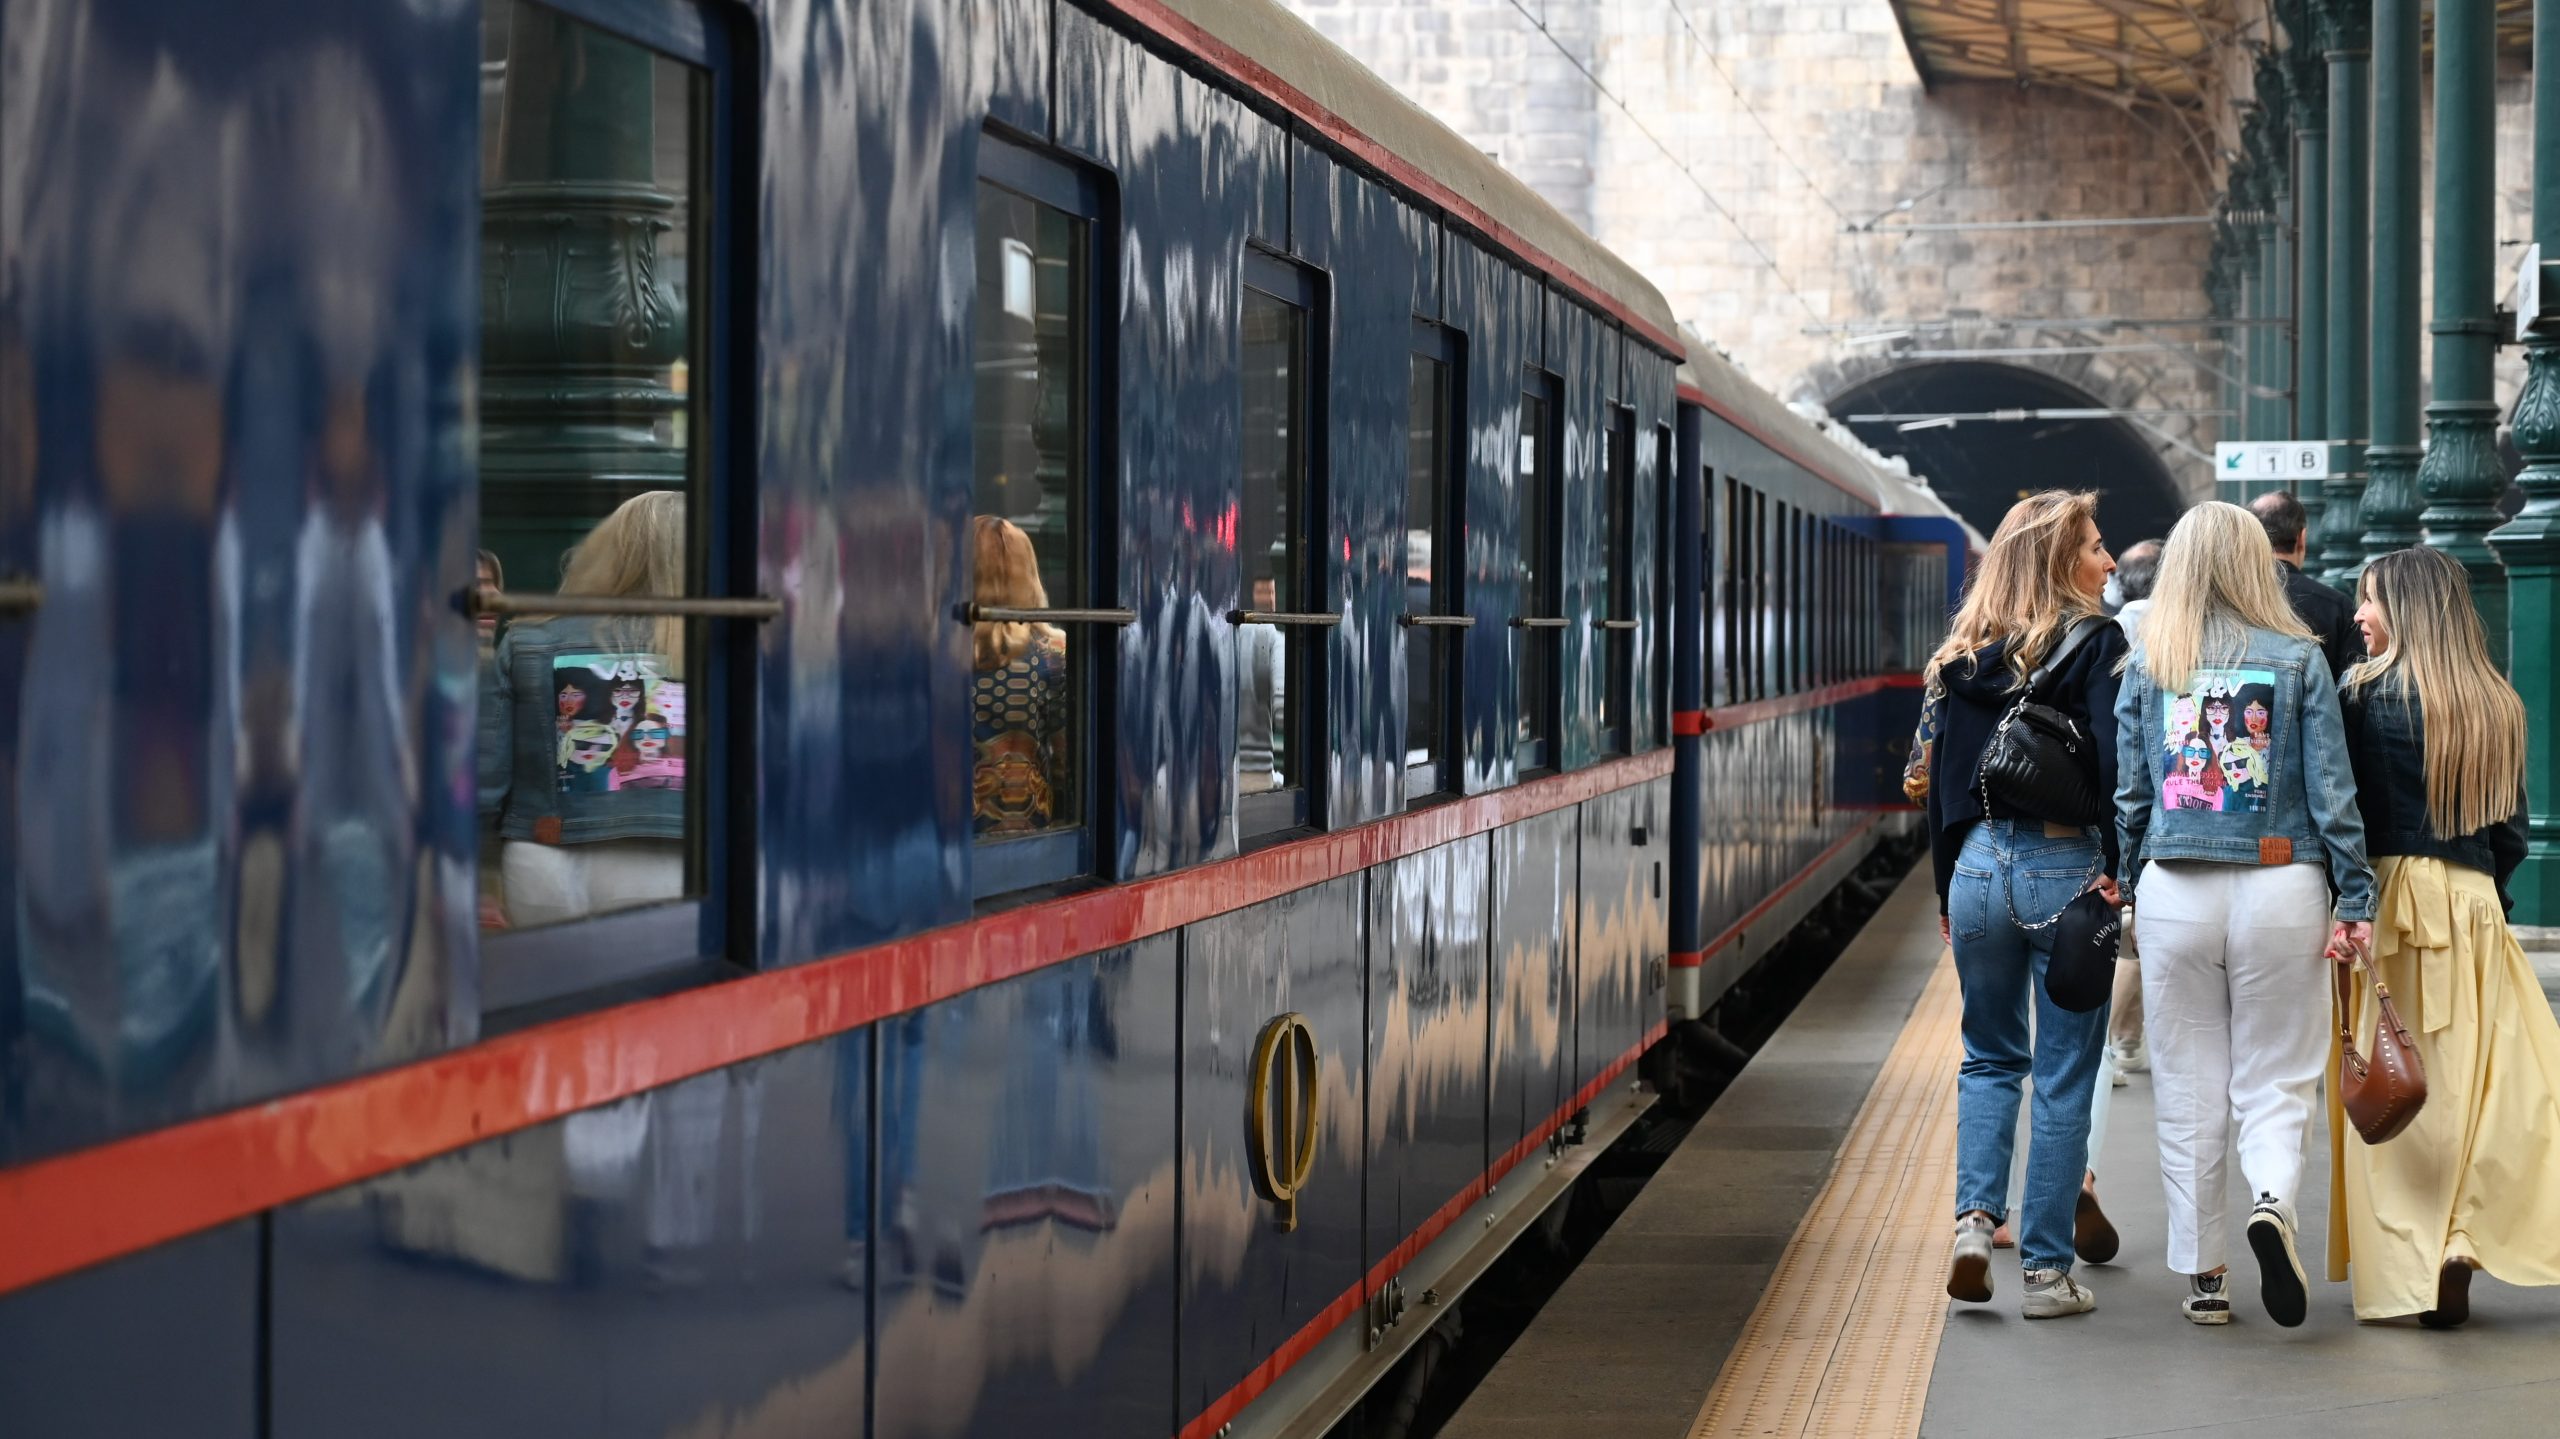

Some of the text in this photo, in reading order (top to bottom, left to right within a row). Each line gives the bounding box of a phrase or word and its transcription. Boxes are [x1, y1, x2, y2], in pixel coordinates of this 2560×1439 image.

[2268, 451, 2315, 473] 1 B
[2192, 677, 2247, 698] Z&V
[2166, 779, 2184, 787] RULE
[2262, 840, 2289, 850] ZADIG
[2262, 853, 2290, 862] DENIM
